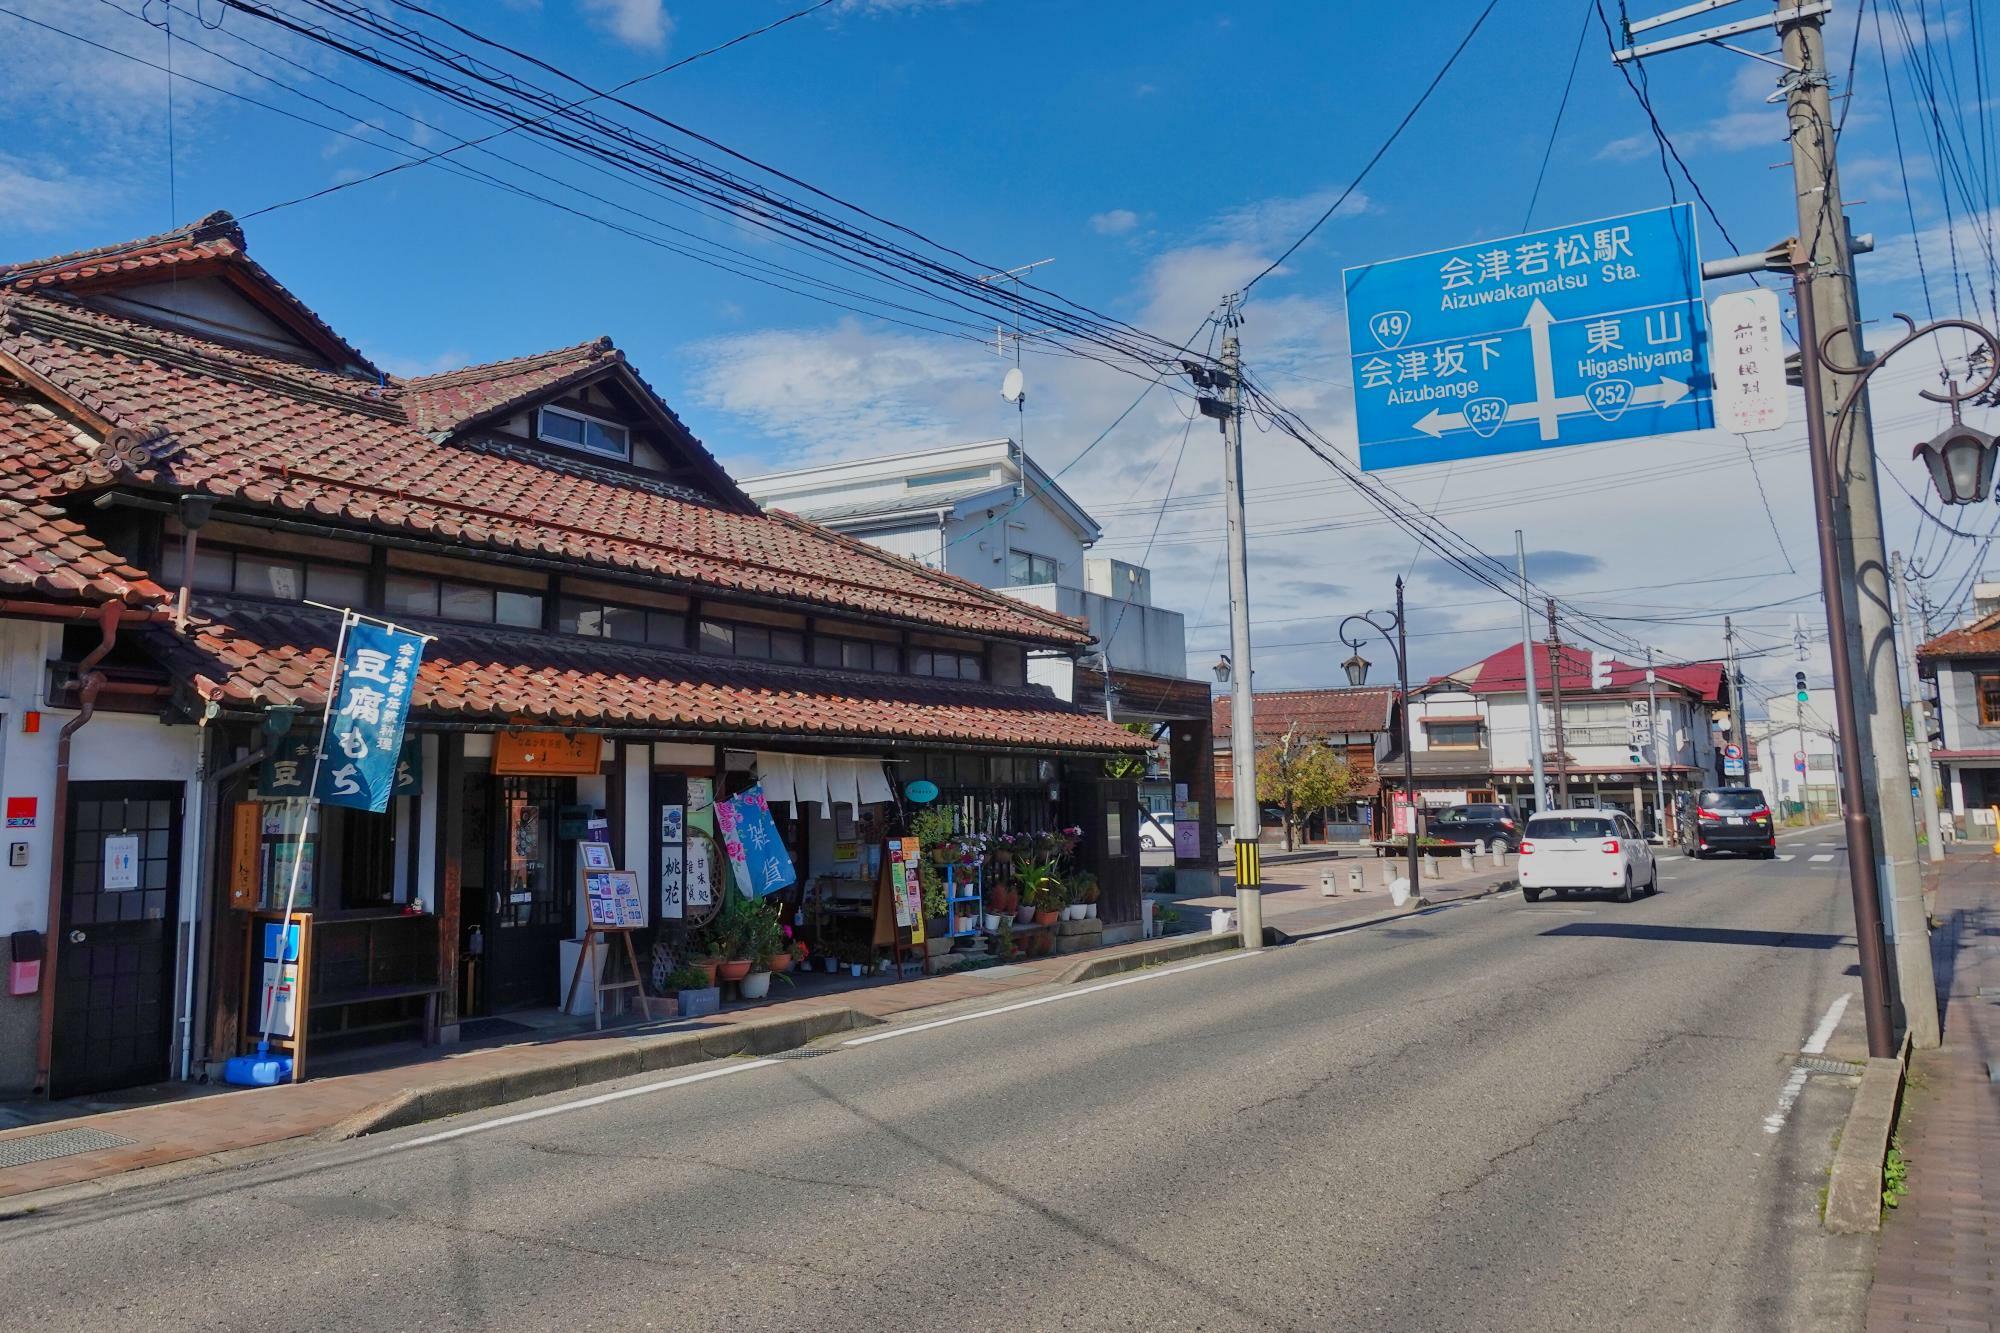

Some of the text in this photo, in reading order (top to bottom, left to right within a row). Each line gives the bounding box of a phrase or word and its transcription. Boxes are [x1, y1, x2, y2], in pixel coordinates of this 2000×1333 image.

[1440, 227, 1633, 290] 会津若松駅
[1441, 263, 1640, 311] Aizuwakamatsu Sta.
[1378, 316, 1402, 337] 49
[1585, 312, 1682, 354] 東山
[1361, 337, 1502, 389] 会津坂下
[1578, 348, 1694, 379] Higashiyama
[1387, 379, 1479, 405] Aizubange
[1471, 402, 1500, 423] 252
[1595, 384, 1625, 406] 252
[331, 649, 391, 797] 豆腐もち
[663, 856, 681, 905] 桃花
[697, 858, 709, 902] 甘味処
